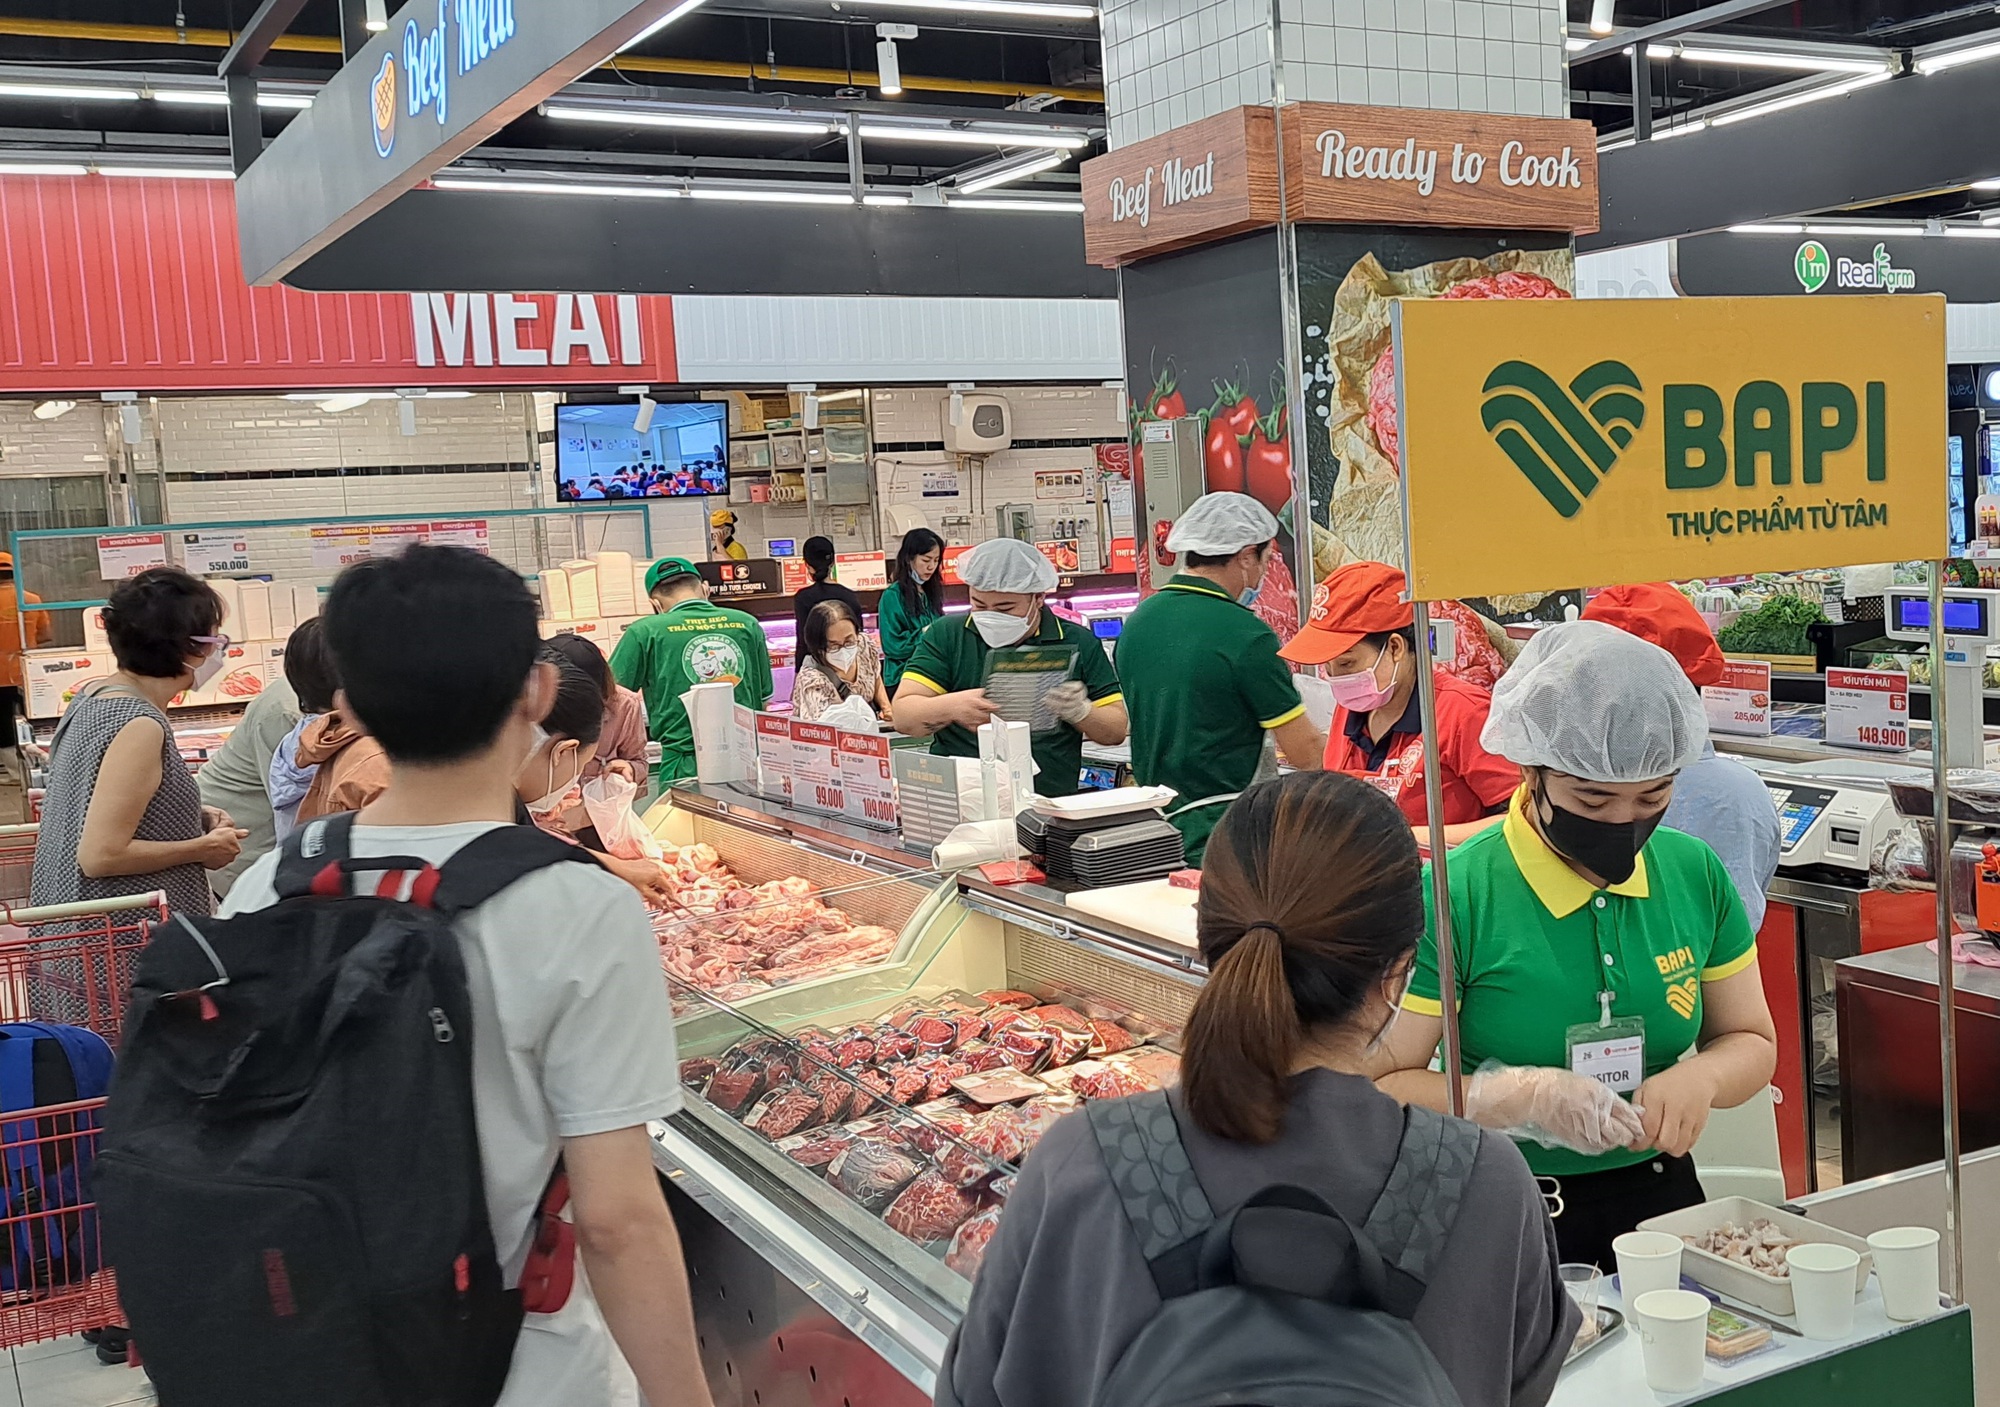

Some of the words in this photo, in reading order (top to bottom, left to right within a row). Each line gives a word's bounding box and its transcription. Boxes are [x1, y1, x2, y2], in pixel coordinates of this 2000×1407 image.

[403, 0, 448, 125] Beef
[1315, 129, 1437, 196] Ready
[1451, 143, 1487, 184] to
[1499, 140, 1582, 188] Cook
[1109, 166, 1153, 228] Beef
[1162, 151, 1215, 208] Meat
[1663, 380, 1886, 489] BAPI
[1666, 508, 1733, 542] THỰC
[1736, 495, 1804, 534] PHẨM
[1807, 498, 1840, 530] TỪ
[1841, 498, 1888, 528] TÂM
[684, 618, 707, 626] THỊT
[1842, 674, 1874, 687] KHUYẾN
[1875, 676, 1891, 688] MÃI
[1857, 726, 1906, 747] 148,900
[815, 785, 844, 809] 99,000
[863, 797, 895, 822] 109,000
[1654, 945, 1695, 975] BAPI
[1591, 1070, 1630, 1084] SITOR
